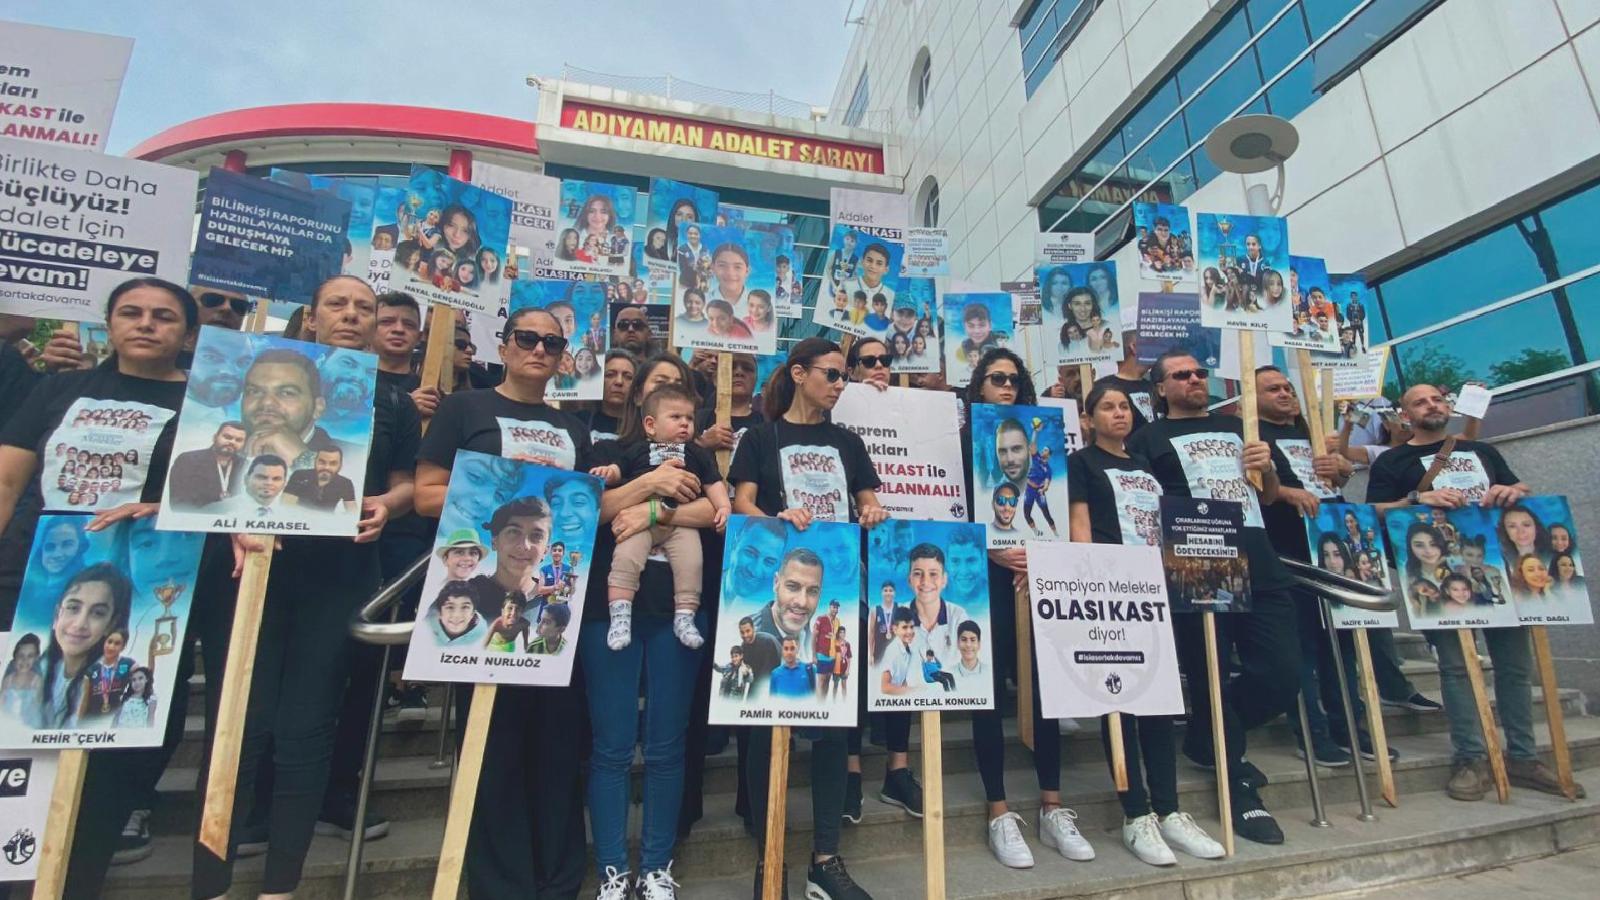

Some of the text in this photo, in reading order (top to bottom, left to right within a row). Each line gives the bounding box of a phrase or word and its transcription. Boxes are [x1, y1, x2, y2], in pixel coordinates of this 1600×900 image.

[0, 82, 39, 99] ları
[58, 108, 85, 124] ile
[573, 109, 875, 172] ADIYAMAN ADALET SARAYI
[85, 170, 158, 196] Daha
[212, 196, 342, 234] BİLİRKİŞİ RAPORUNU
[517, 203, 549, 216] KAST
[207, 221, 291, 246] DURUŞMAYA
[210, 209, 333, 244] HAZIRLAYANLAR DA
[205, 232, 269, 253] GELECEK
[0, 231, 156, 271] ücadeleye
[536, 268, 568, 280] OLASI
[404, 285, 432, 299] HAYAL
[886, 463, 925, 477] KAST
[927, 464, 947, 478] ile
[213, 517, 310, 531] ALİ KARASEL
[992, 538, 1017, 546] OSMAN
[1036, 577, 1161, 597] Şampiyon Melekler
[1036, 598, 1166, 622] OLASI KAST
[1088, 627, 1126, 645] diyor!
[440, 652, 541, 668] İZCAN NURLUÖZ
[875, 697, 988, 707] ATAKAN CELAL KONUKLU
[740, 708, 829, 720] PAMİR KONUKLU
[32, 732, 117, 745] NEHİR ÇEVİK
